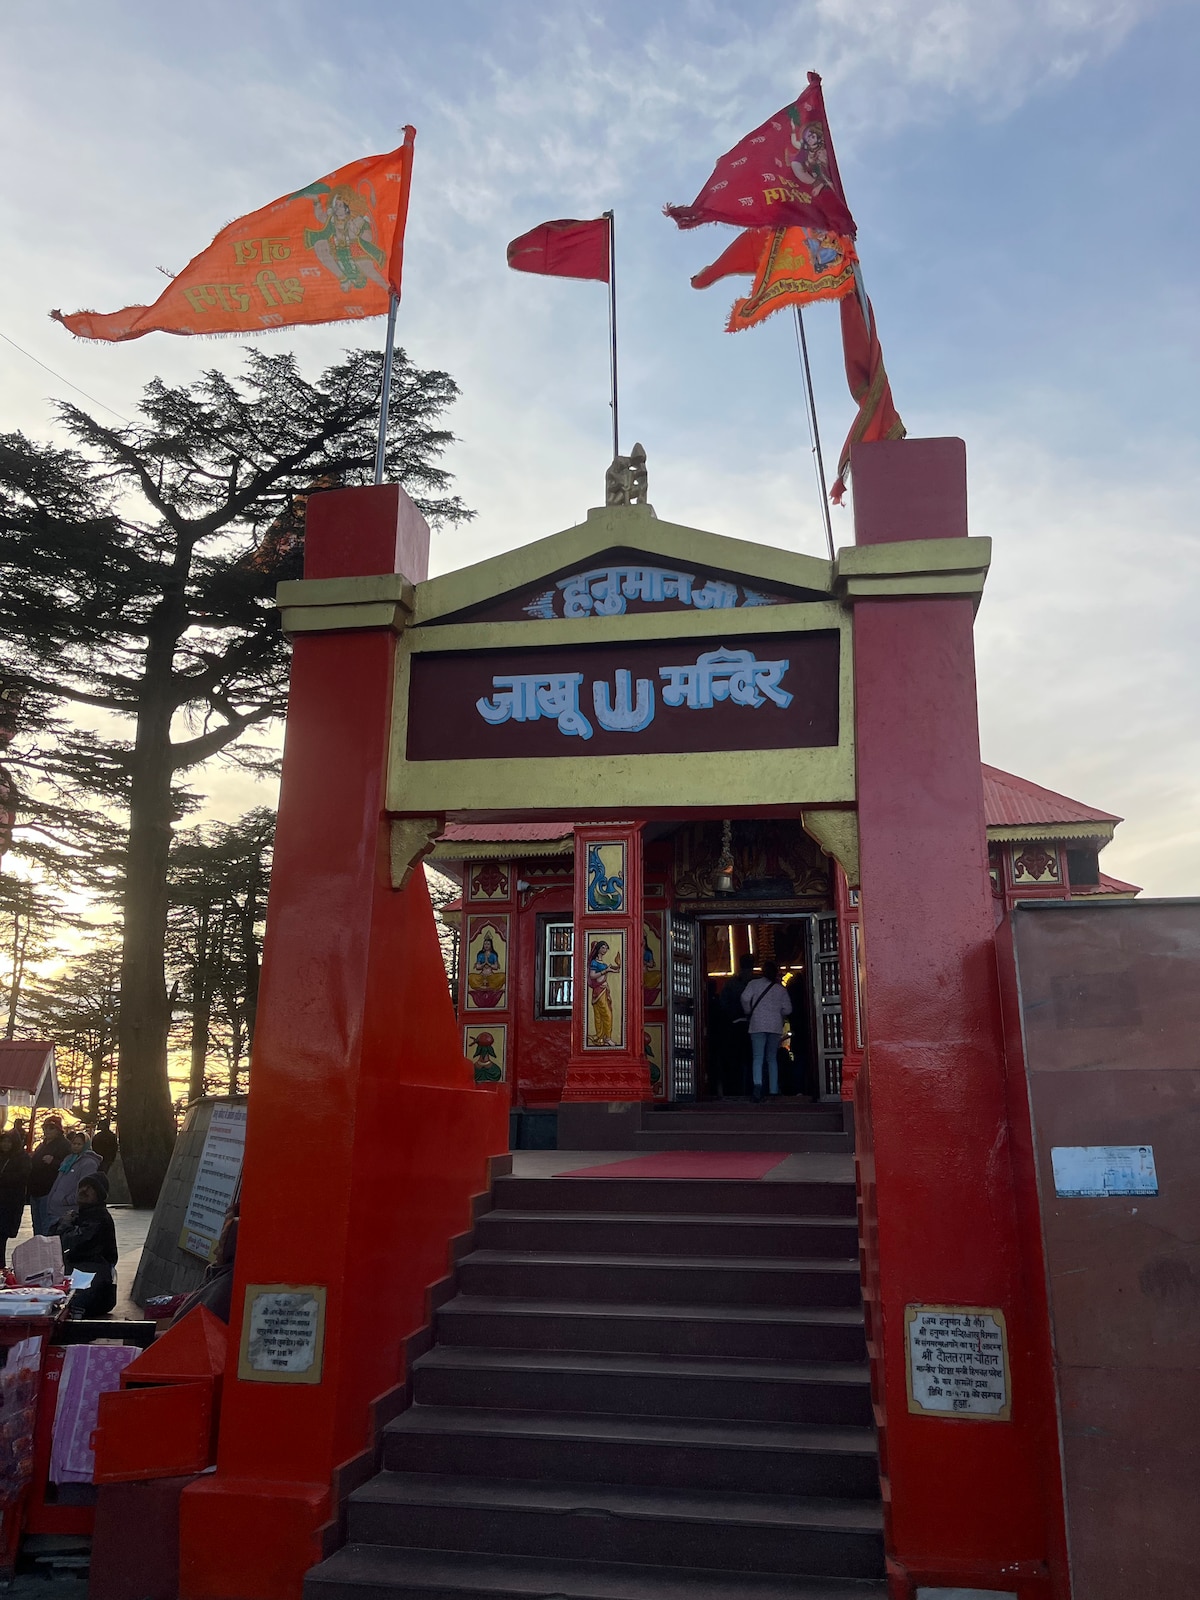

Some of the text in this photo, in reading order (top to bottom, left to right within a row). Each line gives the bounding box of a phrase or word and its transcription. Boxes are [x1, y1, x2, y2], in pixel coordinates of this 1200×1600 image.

[555, 567, 737, 618] हनुमान जी
[476, 646, 794, 741] जाखू मन्दिर
[940, 1318, 960, 1328] हनुमान
[962, 1317, 970, 1326] जी
[919, 1327, 927, 1336] श्री
[930, 1329, 949, 1339] हनुमान
[980, 1331, 998, 1339] शिमला
[922, 1349, 999, 1365] श्री दौलत राम चौहान
[932, 1376, 939, 1384] के
[971, 1389, 980, 1398] को
